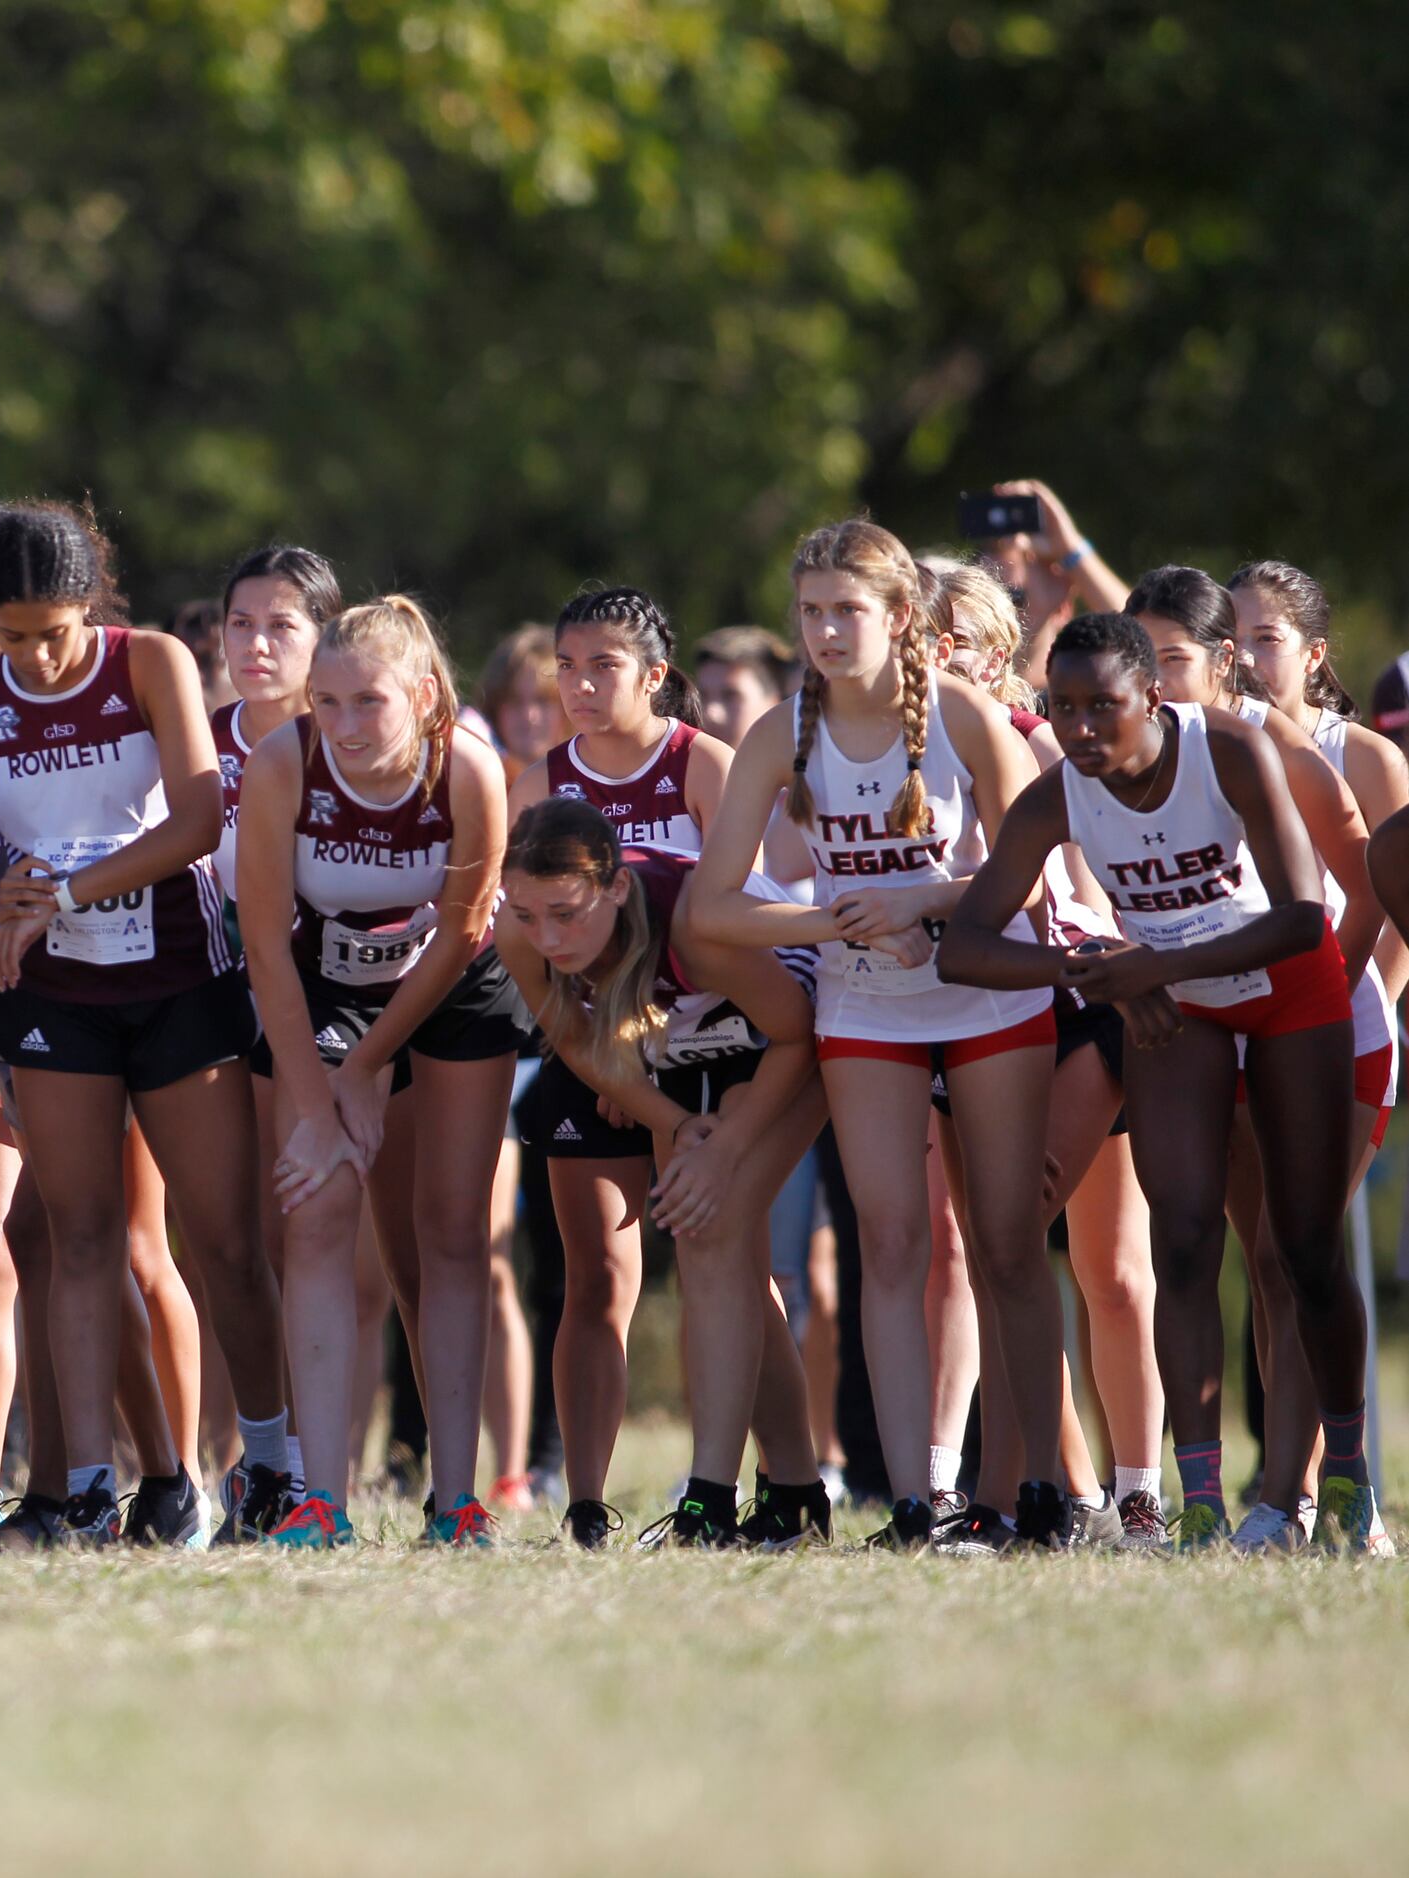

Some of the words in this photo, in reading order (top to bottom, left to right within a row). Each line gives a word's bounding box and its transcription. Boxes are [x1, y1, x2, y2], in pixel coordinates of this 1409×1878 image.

[44, 723, 77, 739] GISD
[8, 736, 122, 779] ROWLETT
[602, 803, 632, 816] GISD
[358, 827, 392, 843] GISD
[618, 816, 672, 843] LETT
[62, 842, 76, 850] UIL
[79, 841, 114, 851] Region
[313, 837, 432, 869] ROWLETT
[48, 854, 62, 862] XC
[812, 839, 948, 876] LEGACY
[1107, 842, 1227, 886] TYLER
[1108, 864, 1242, 912] LEGACY
[1149, 920, 1225, 944] Championships
[1162, 919, 1196, 935] Region
[20, 1042, 50, 1052] adidas
[553, 1132, 582, 1140] adidas
